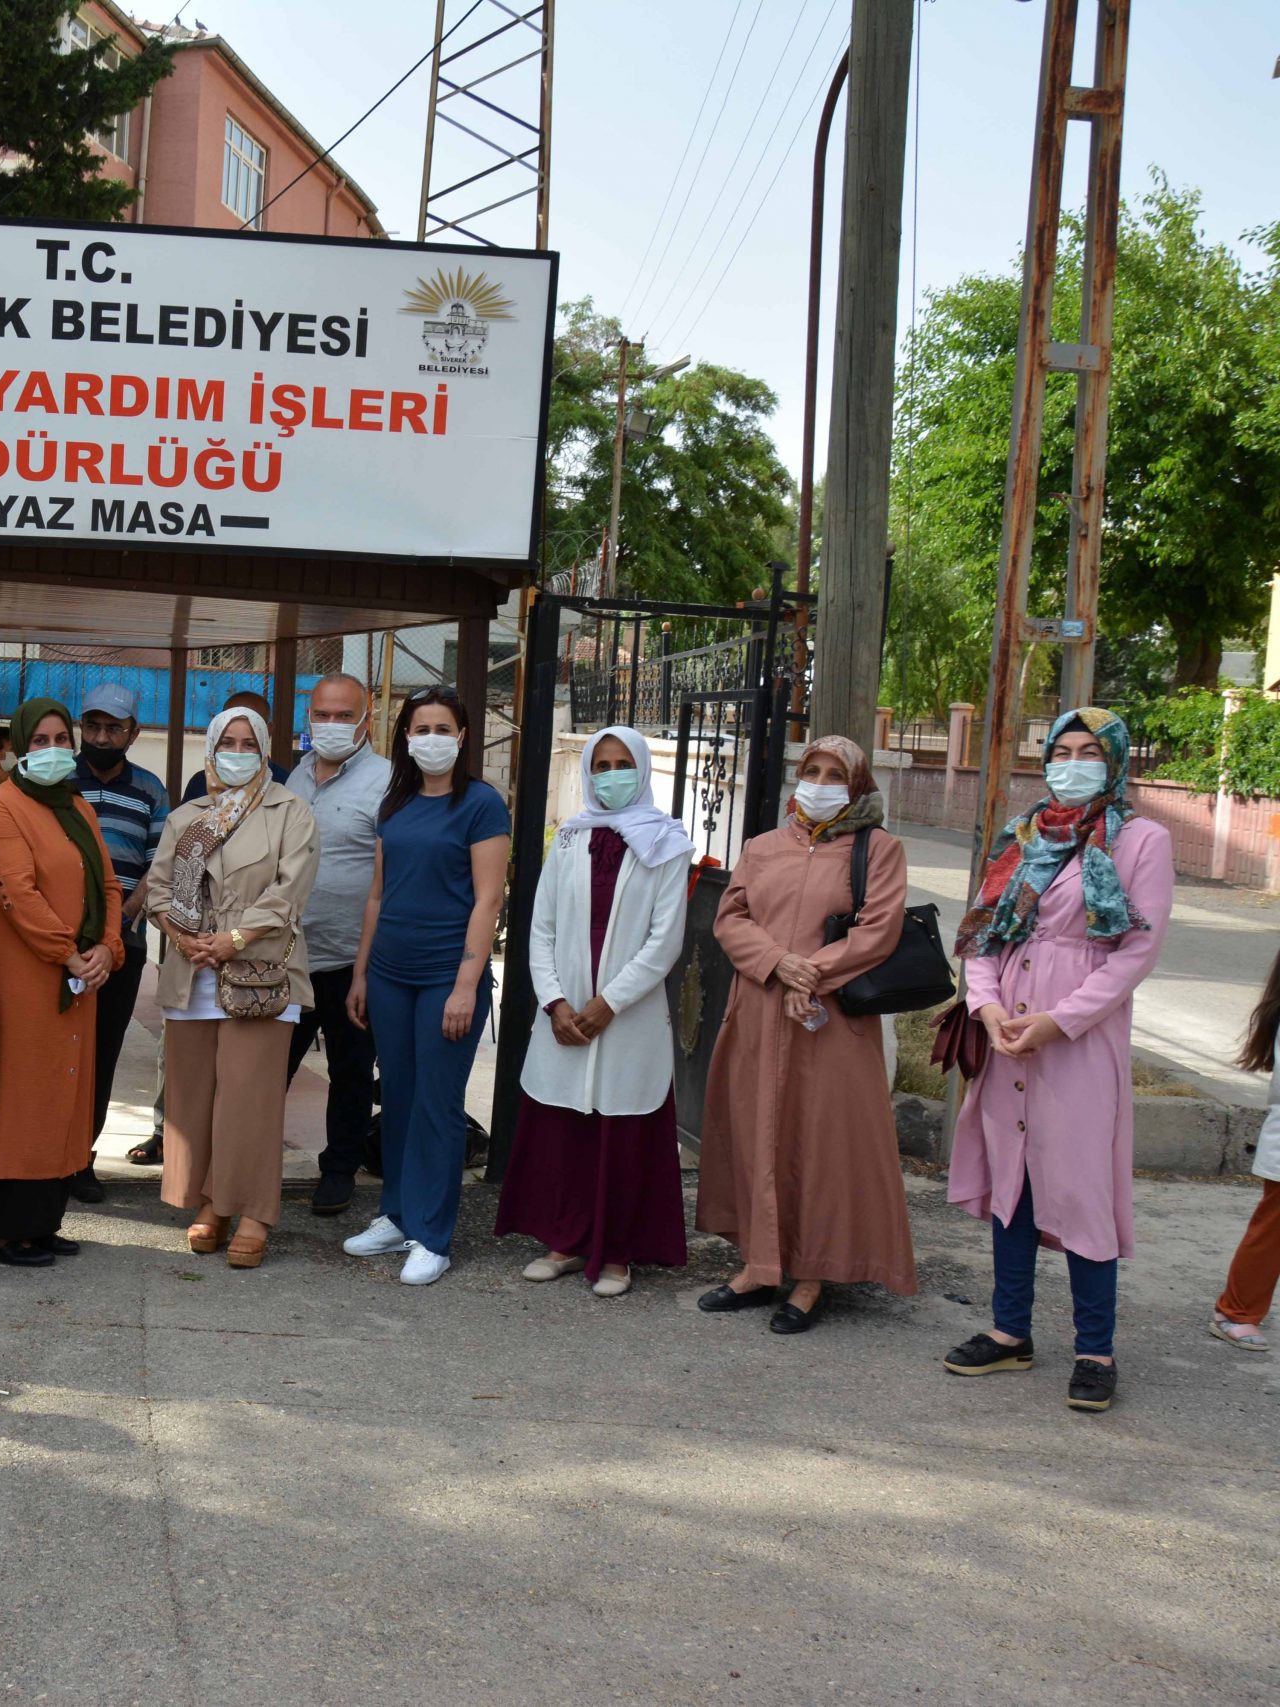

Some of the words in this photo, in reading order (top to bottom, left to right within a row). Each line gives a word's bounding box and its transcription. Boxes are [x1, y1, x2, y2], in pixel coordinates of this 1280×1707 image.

[36, 239, 132, 284] T.C.
[52, 297, 369, 358] BELEDİYESİ
[418, 364, 489, 375] BELEDİYESİ
[250, 371, 449, 438] İŞLERİ
[90, 498, 216, 537] MASA
